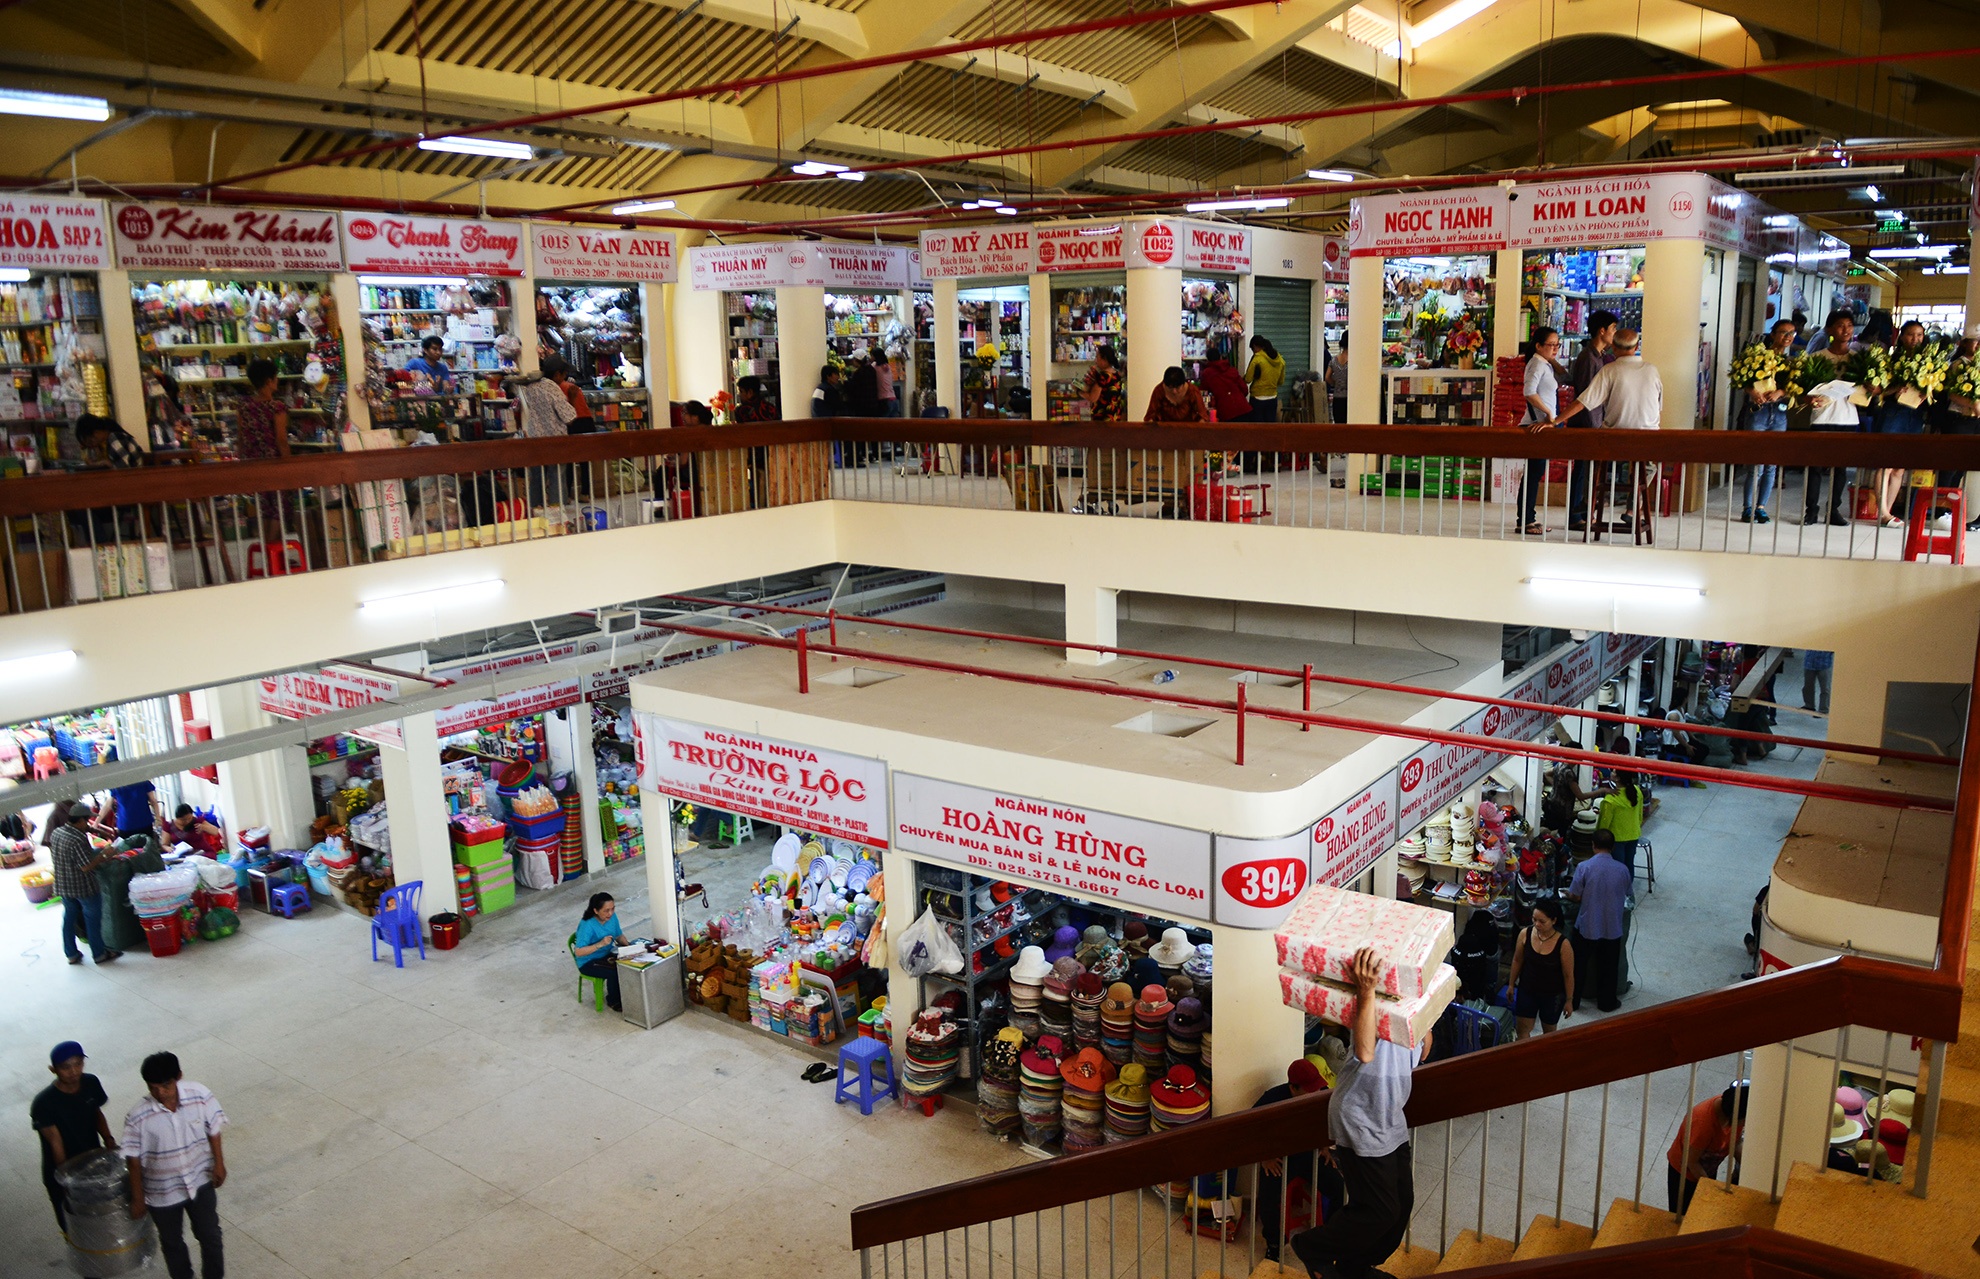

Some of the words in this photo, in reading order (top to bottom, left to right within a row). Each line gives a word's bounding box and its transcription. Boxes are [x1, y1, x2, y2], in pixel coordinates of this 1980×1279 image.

[1537, 184, 1581, 198] NGÀNH
[1585, 180, 1621, 195] BÁCH
[1624, 177, 1651, 191] HÓA
[1400, 198, 1430, 207] NGÀNH
[1432, 196, 1456, 205] BÁCH
[1459, 194, 1478, 203] HÓA
[1533, 201, 1576, 221] KIM
[1585, 195, 1646, 217] LOAN
[1673, 200, 1692, 211] 1150
[124, 221, 149, 235] 1013
[156, 207, 230, 241] Kim
[233, 211, 334, 243] Khánh
[1385, 210, 1433, 237] NGỌC
[1440, 206, 1493, 234] HẠNH
[1528, 224, 1568, 235] CHUYÊN
[1588, 220, 1619, 230] PHÒNG
[1622, 216, 1649, 228] PHẨM
[94, 227, 102, 247] 2
[540, 234, 569, 249] 1015
[577, 232, 621, 254] VÂN
[628, 239, 670, 257] ANH
[952, 231, 980, 253] MỸ
[987, 232, 1029, 251] ANH
[1038, 229, 1070, 239] NGÀNH
[1143, 237, 1173, 251] 1082
[1192, 229, 1225, 252] NGỌC
[925, 239, 946, 252] 1027
[1060, 241, 1098, 262] NGỌC
[577, 257, 591, 266] Kim
[711, 256, 747, 273] THUẬN
[751, 255, 767, 270] MỸ
[829, 256, 868, 272] THUẬN
[872, 257, 888, 271] MỸ
[942, 267, 958, 276] 3952
[960, 265, 976, 274] 2264
[982, 264, 999, 273] 0902
[1001, 263, 1013, 272] 568
[1016, 262, 1028, 271] 647
[1282, 259, 1293, 268] 1083
[553, 268, 569, 276] ĐT:
[572, 268, 590, 277] 3952
[592, 269, 610, 277] 2087
[617, 271, 634, 279] 0903
[636, 271, 649, 279] 614
[592, 675, 626, 688] Chuyên:
[1562, 667, 1577, 688] SƠN
[1579, 656, 1593, 677] HOA
[464, 710, 476, 719] CÁC
[522, 696, 531, 705] GIA
[1485, 711, 1498, 732] 392
[704, 730, 763, 751] NGÀNH
[769, 744, 818, 763] NHỰA
[668, 740, 789, 786] TRƯỜNG
[799, 768, 866, 802] LỘC
[1404, 762, 1420, 788] 393
[1426, 754, 1445, 782] THU
[1401, 797, 1421, 818] CHUYÊN
[1429, 789, 1432, 799] &
[1460, 763, 1469, 775] CÁC
[1469, 755, 1479, 768] LOẠI
[776, 802, 802, 816] MELAMINE
[807, 809, 830, 823] ACRYLIC
[834, 815, 841, 825] PC
[845, 818, 868, 832] PLASTIC
[784, 817, 797, 825] 0913
[994, 797, 1048, 818] NGÀNH
[1053, 808, 1086, 825] NÓN
[941, 807, 1044, 846] HOÀNG
[1055, 830, 1147, 868] HÙNG
[1318, 821, 1330, 841] 394
[1326, 821, 1360, 862] HOÀNG
[1362, 801, 1386, 836] HÙNG
[899, 823, 955, 845] CHUYÊN
[959, 836, 989, 853] MUA
[994, 844, 1023, 860] BÁN
[1028, 850, 1043, 864] SỈ
[1047, 857, 1057, 867] &
[1063, 858, 1081, 873] LẺ
[1087, 865, 1122, 881] NÓN
[1125, 872, 1159, 890] CÁC
[1165, 882, 1205, 900] LOẠI
[1335, 859, 1345, 874] MUA
[1346, 851, 1355, 865] BÁN
[998, 862, 1120, 897] 028.3751.6667
[1241, 862, 1296, 901] 394
